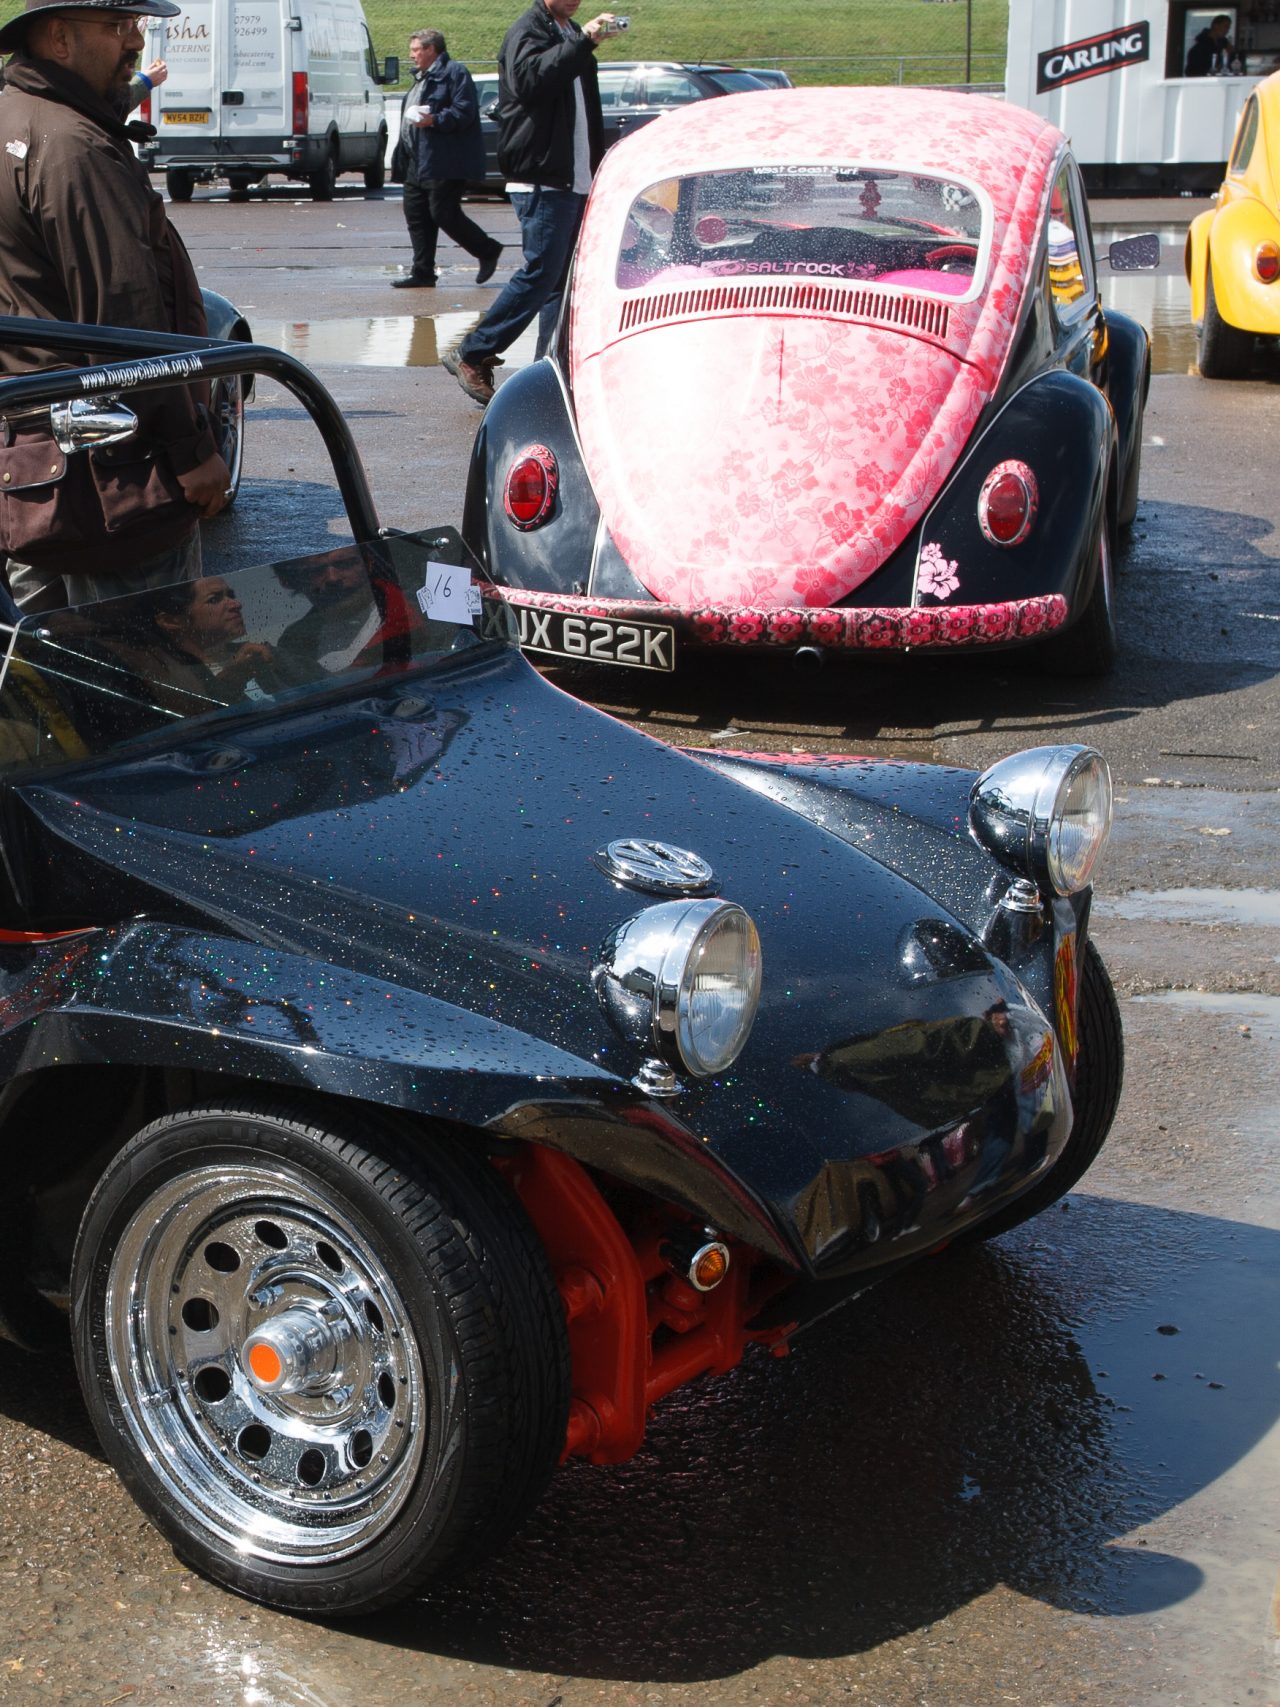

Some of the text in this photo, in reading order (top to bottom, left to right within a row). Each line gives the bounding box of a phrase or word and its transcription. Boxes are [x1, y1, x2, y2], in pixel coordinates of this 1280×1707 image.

[234, 16, 261, 25] 07979
[164, 45, 210, 53] CATERING
[1044, 33, 1142, 79] CARLING
[753, 165, 859, 175] West Coast Surf
[80, 354, 203, 389] www.buggyclubuk.org.uk
[434, 574, 452, 598] 16
[563, 617, 669, 667] 622K
